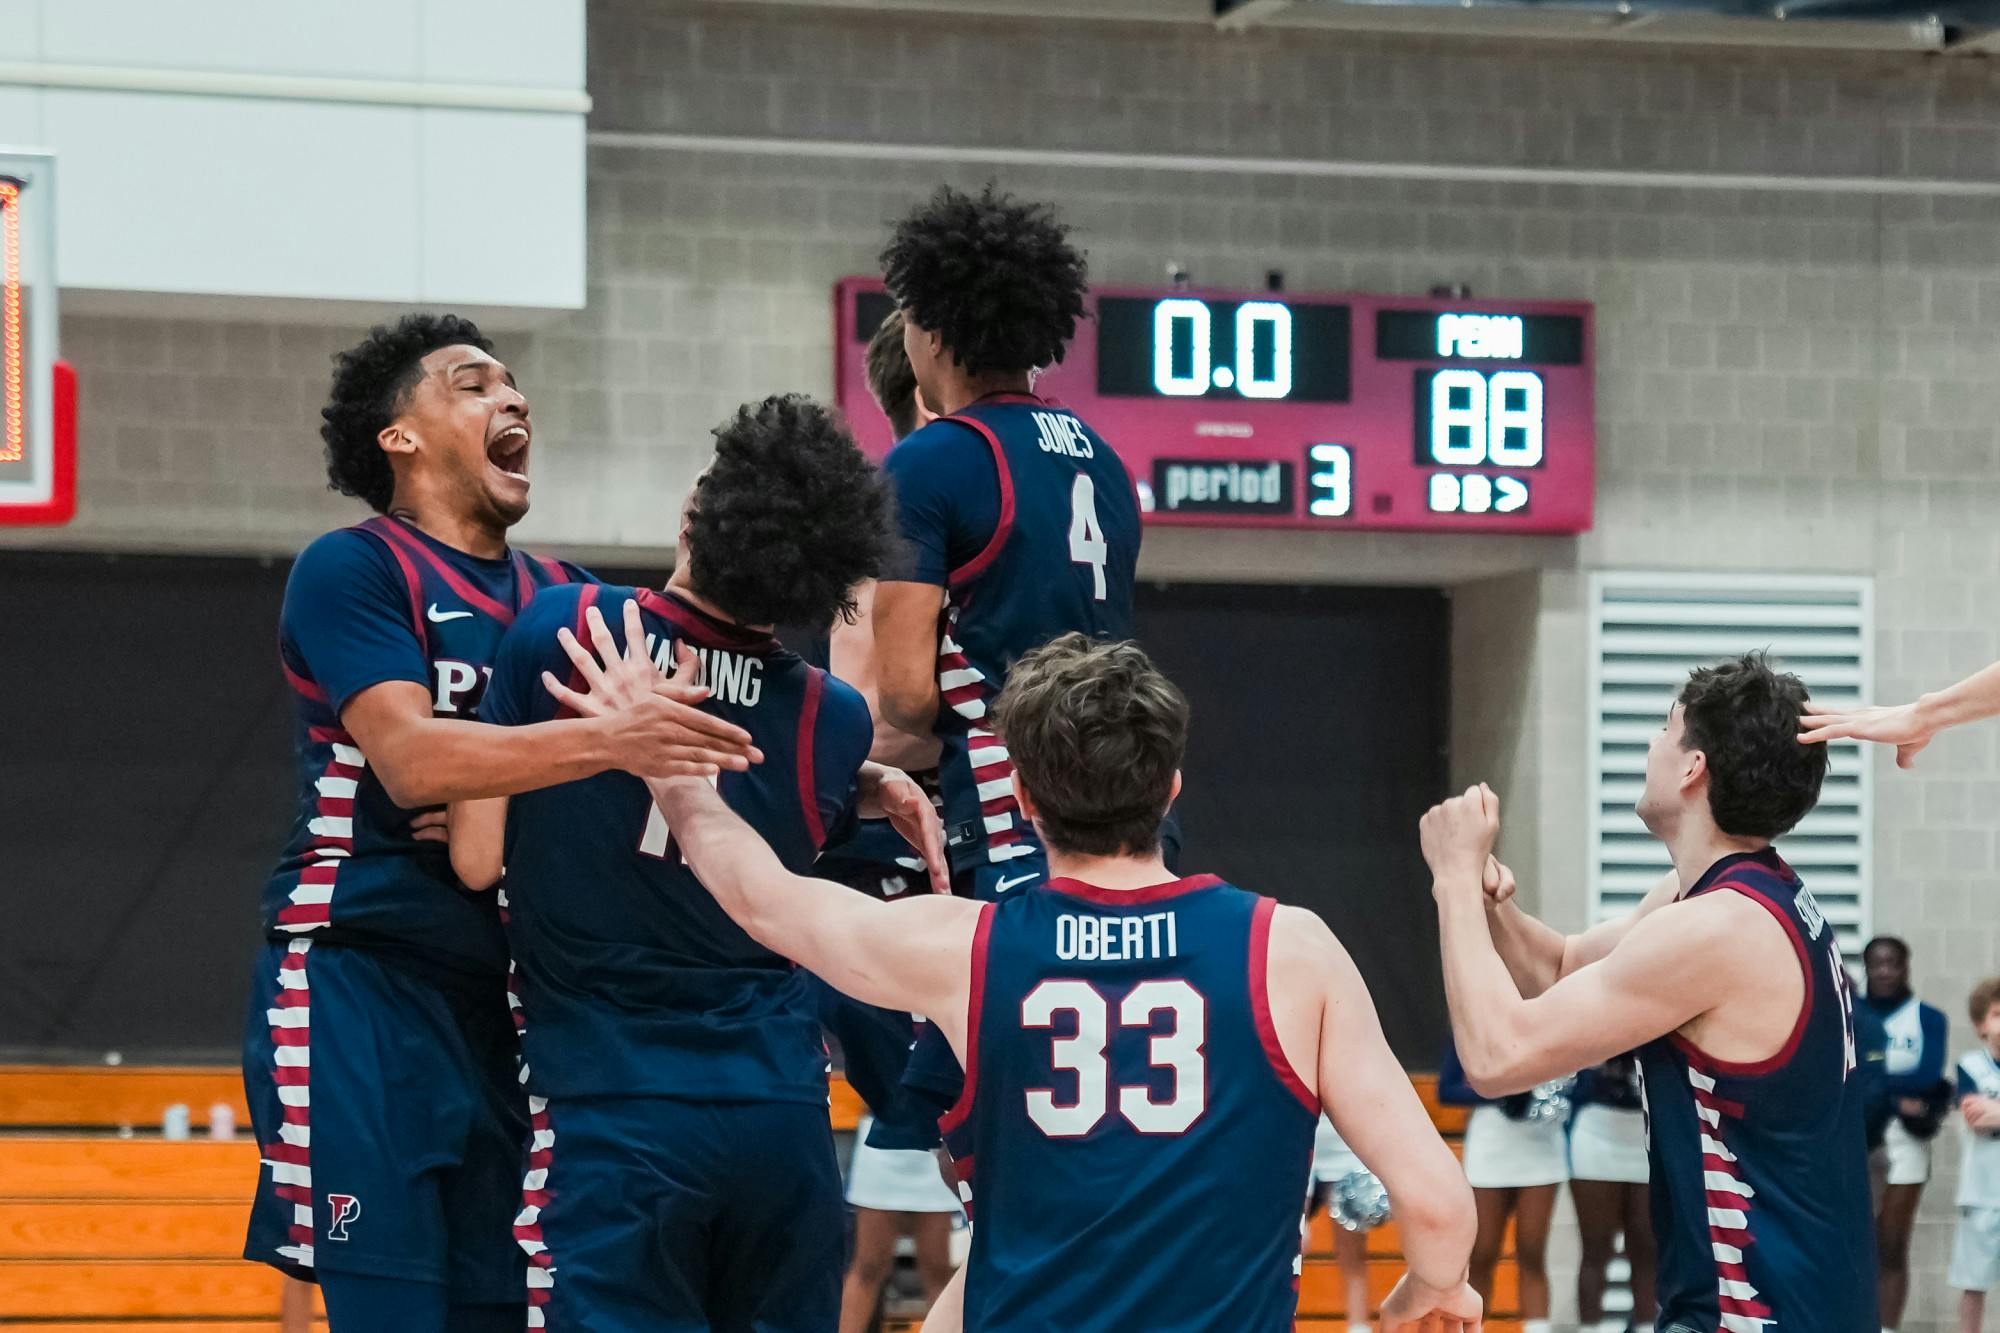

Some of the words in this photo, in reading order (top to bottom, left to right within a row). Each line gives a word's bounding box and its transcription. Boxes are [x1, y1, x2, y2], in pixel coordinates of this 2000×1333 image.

[1153, 298, 1292, 399] 0.0
[1438, 312, 1523, 359] PENN
[1031, 411, 1094, 460] JONES
[1431, 369, 1543, 467] 88
[1166, 460, 1281, 510] period
[1309, 443, 1350, 516] 3
[1069, 472, 1108, 601] 4
[1056, 911, 1178, 961] OBERTI
[1020, 977, 1208, 1138] 33
[327, 1193, 361, 1241] P
